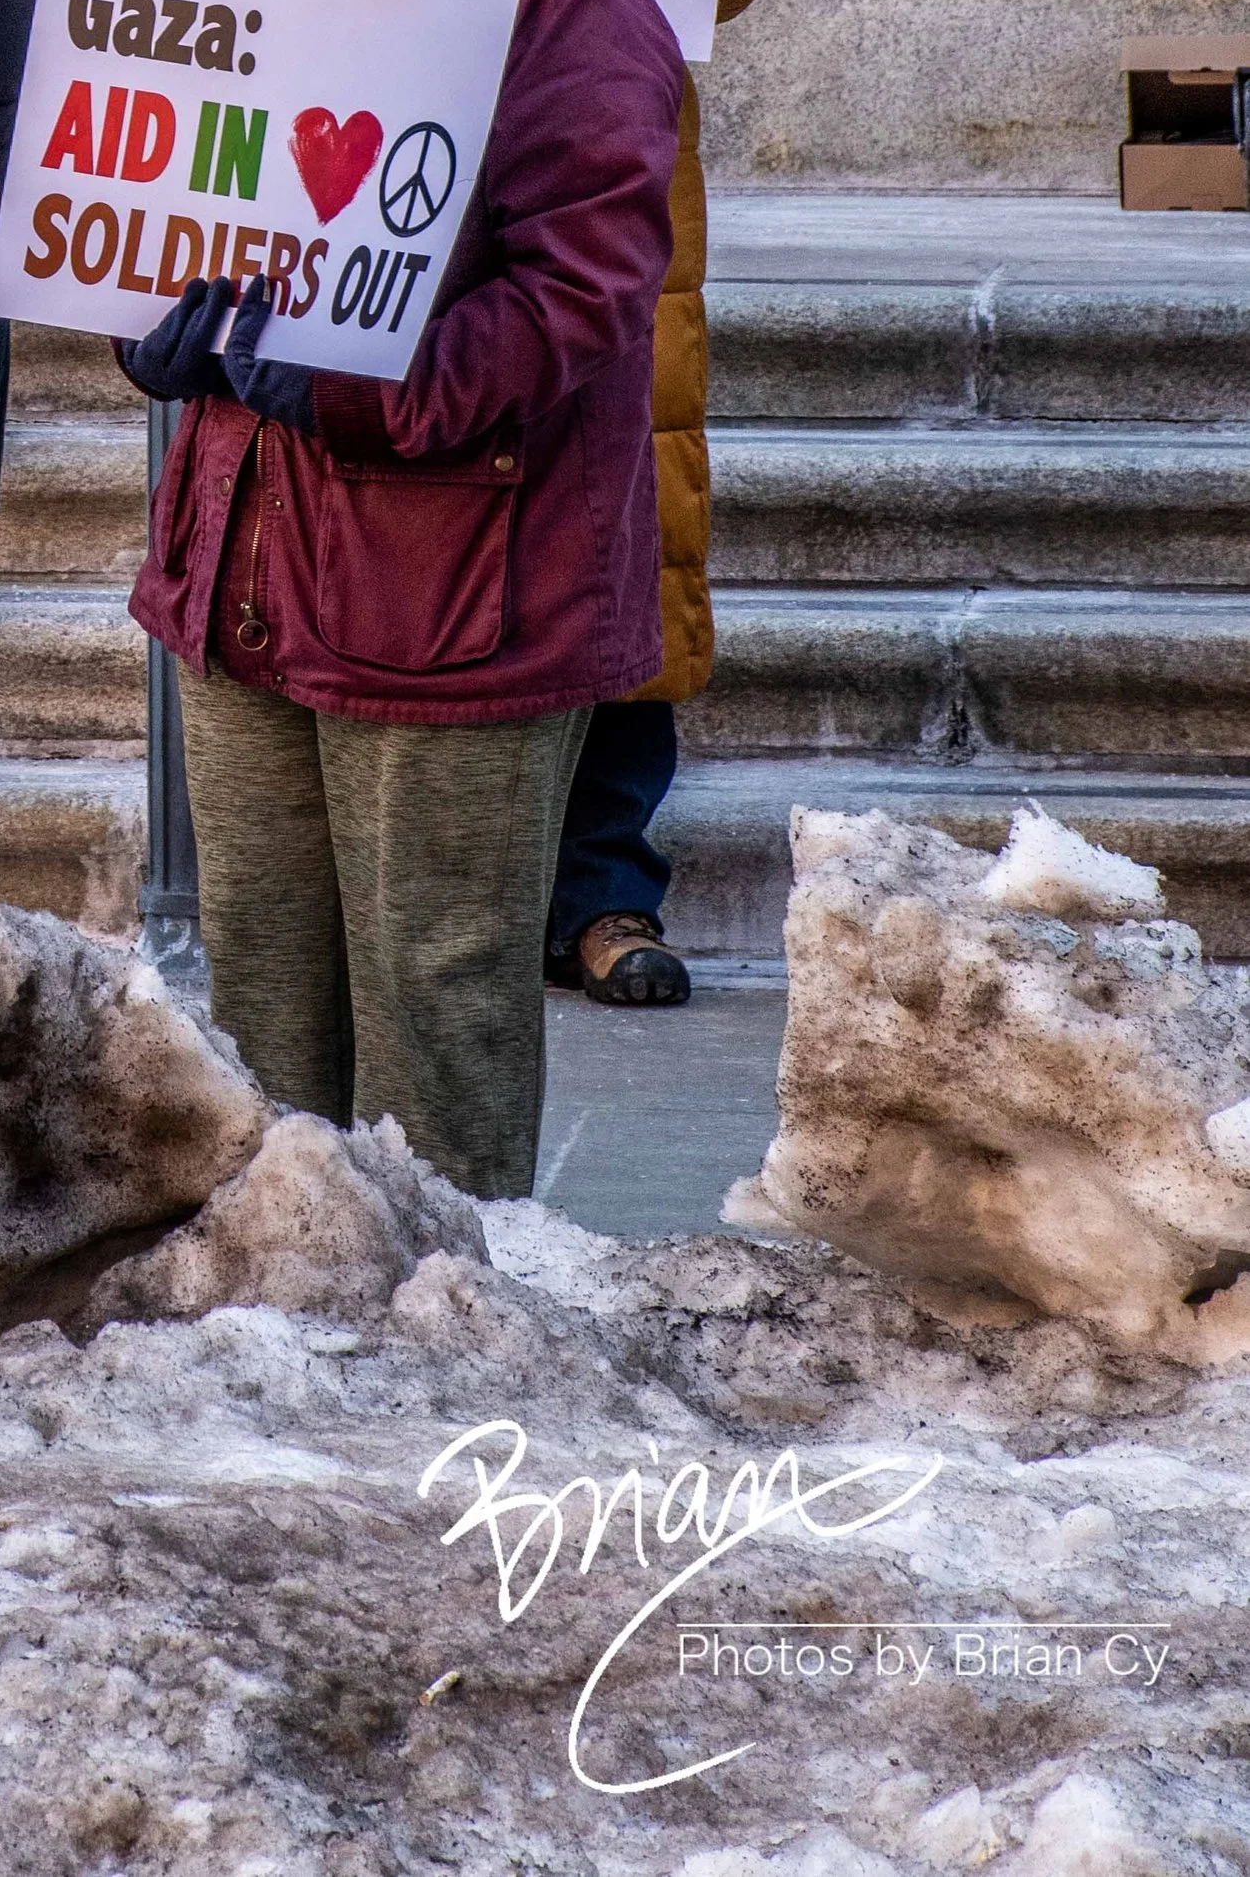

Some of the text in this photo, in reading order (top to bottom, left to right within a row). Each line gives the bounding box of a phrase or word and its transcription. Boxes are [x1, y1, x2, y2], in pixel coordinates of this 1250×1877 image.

[40, 80, 269, 201] AID IN
[23, 193, 432, 333] SOLDIERS OUT
